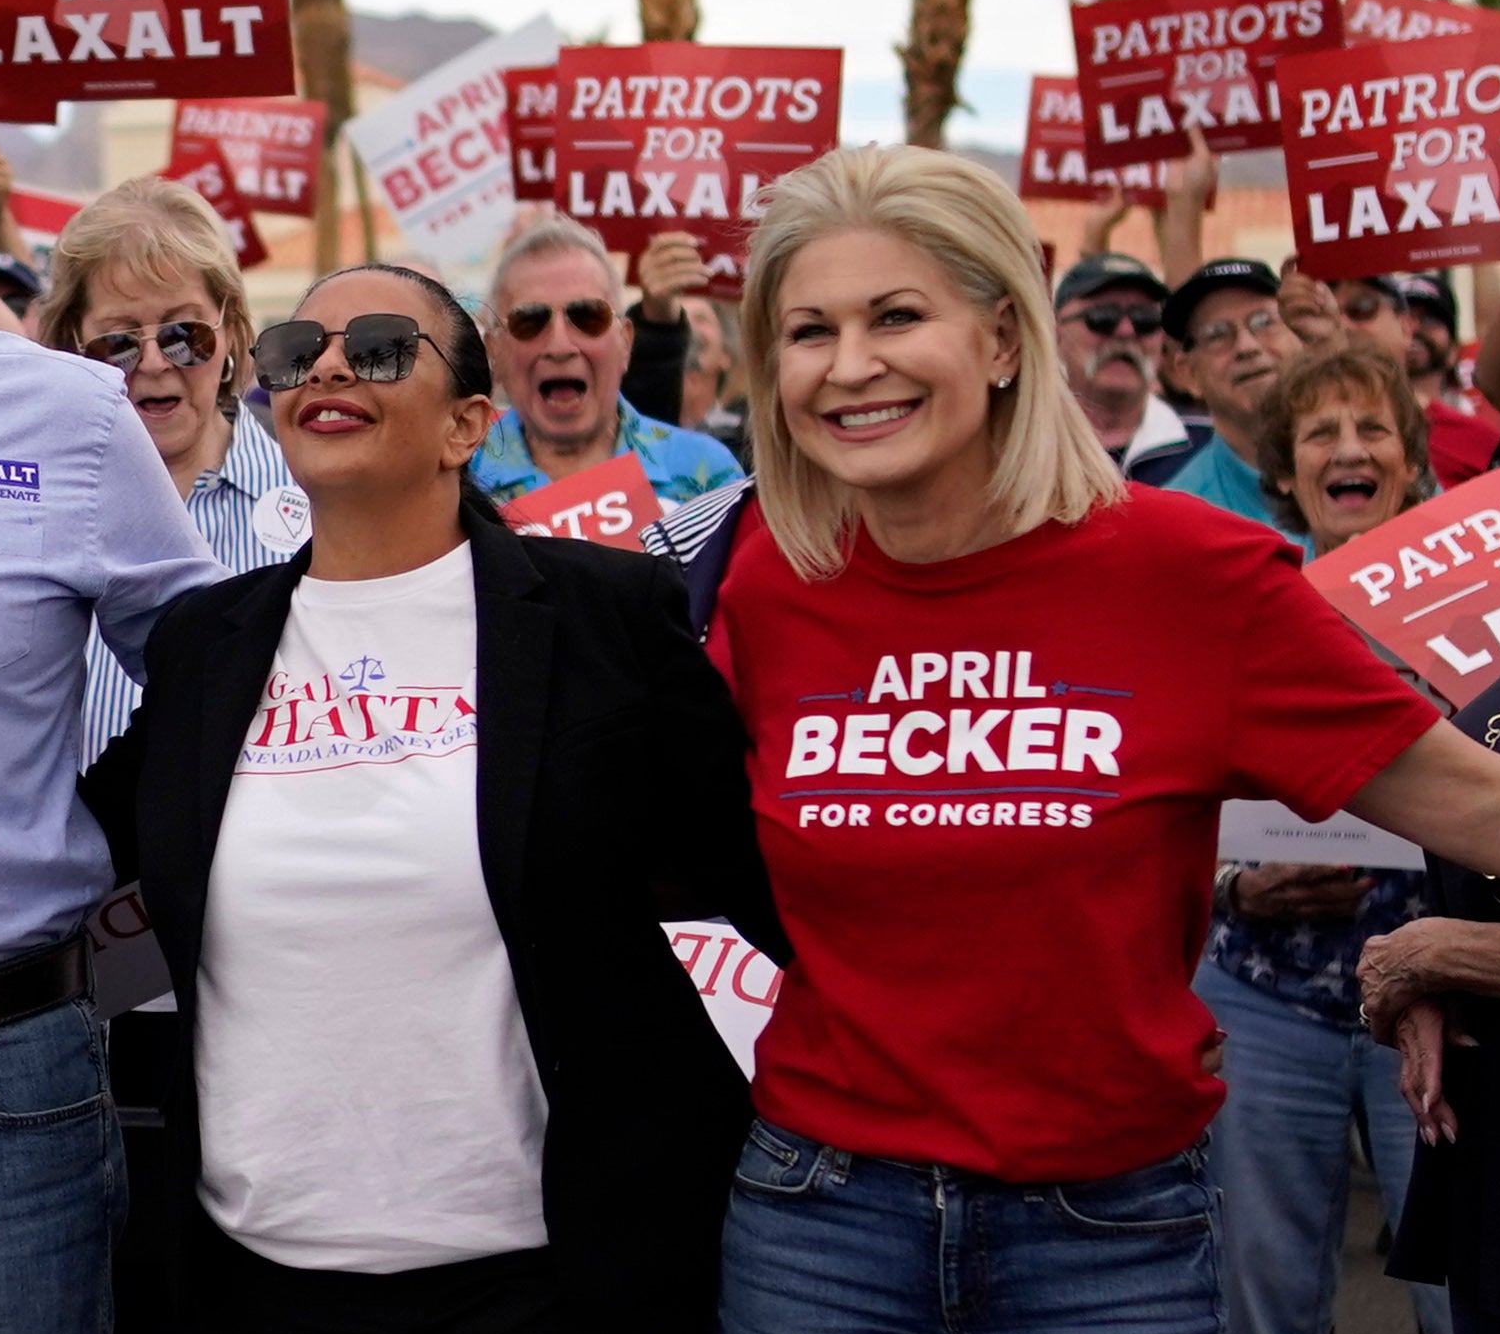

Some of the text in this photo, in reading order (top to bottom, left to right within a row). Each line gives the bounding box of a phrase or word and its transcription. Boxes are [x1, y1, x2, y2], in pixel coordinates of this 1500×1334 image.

[1173, 46, 1249, 86] FOR
[414, 68, 505, 141] APRI
[570, 75, 823, 123] PATRIOTS
[641, 125, 725, 162] FOR
[1392, 124, 1487, 171] FOR
[868, 650, 1047, 705] APRIL
[250, 694, 478, 749] HATTA
[785, 708, 1123, 780] BECKER
[240, 744, 323, 767] NEVADA
[326, 731, 436, 760] ATTORNEY
[799, 799, 1094, 829] FOR CONGRESS
